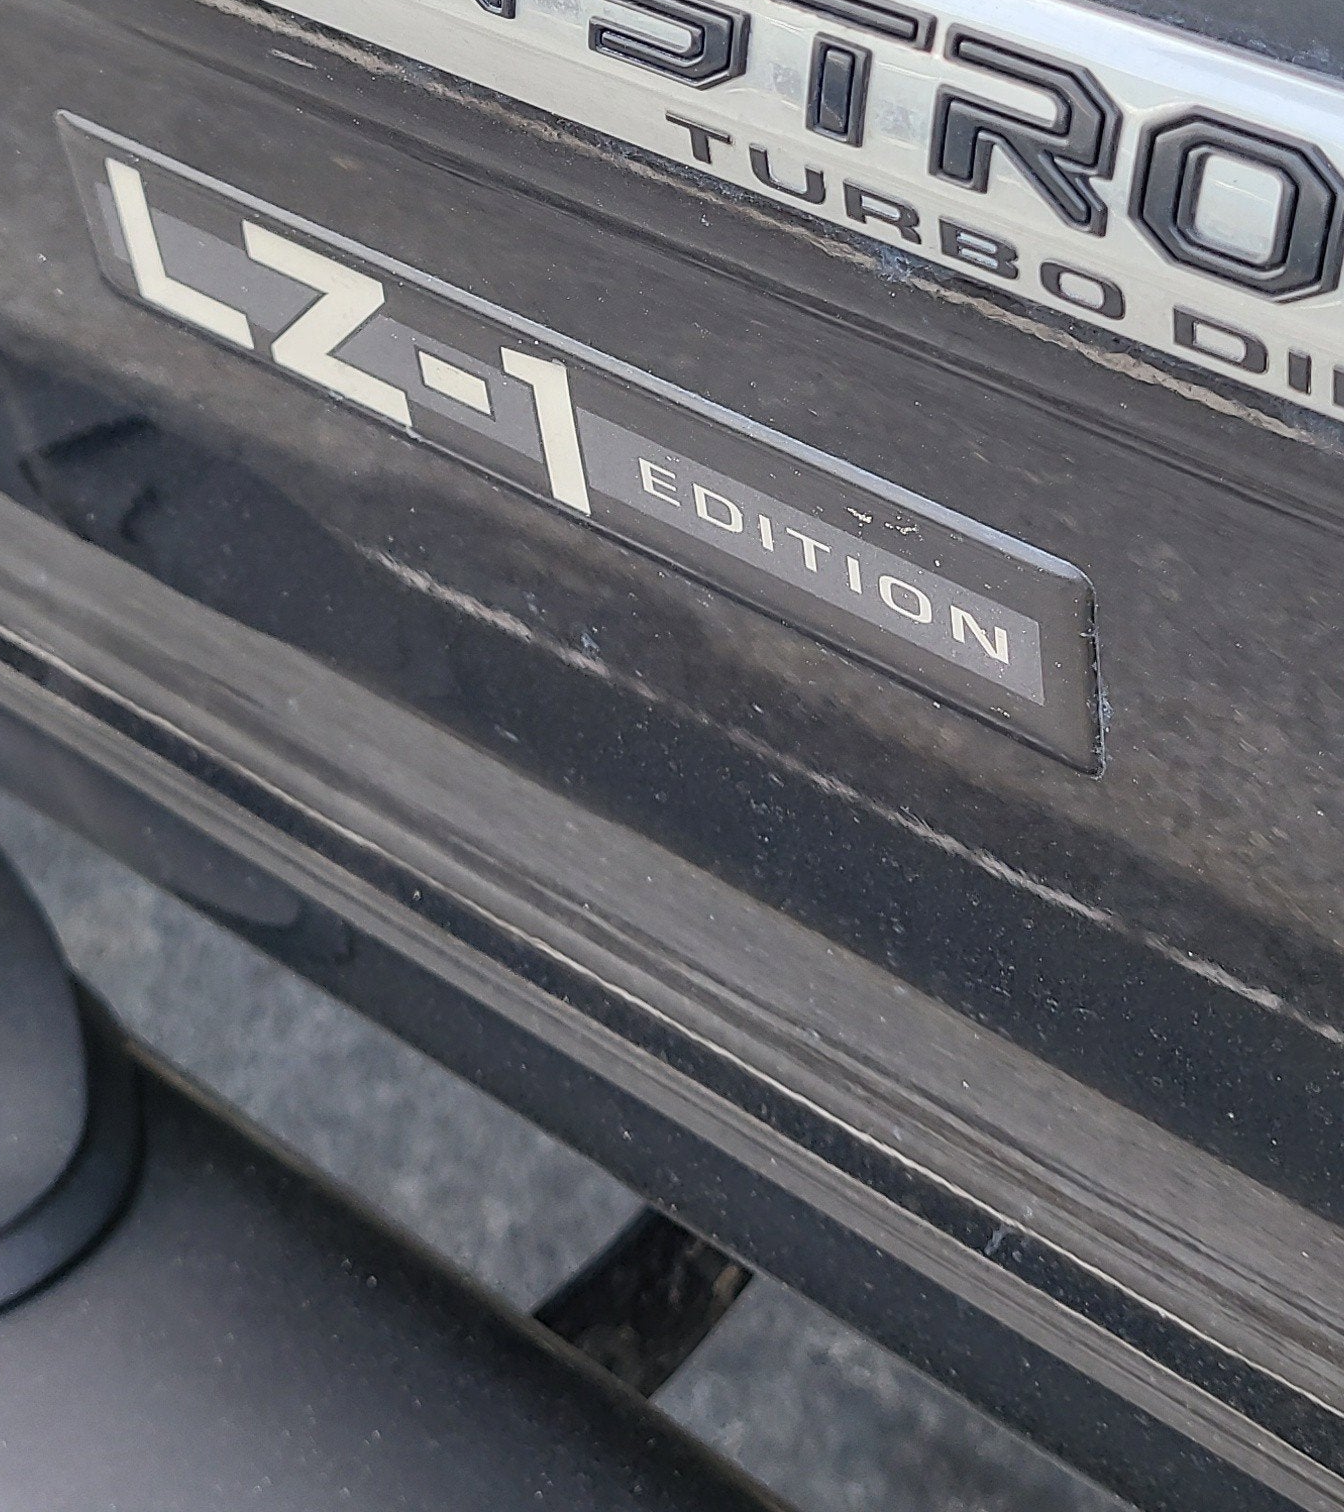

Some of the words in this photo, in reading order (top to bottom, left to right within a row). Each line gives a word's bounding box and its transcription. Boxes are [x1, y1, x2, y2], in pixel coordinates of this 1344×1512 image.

[665, 110, 1126, 320] TURBO
[105, 157, 591, 516] LZ-1
[638, 456, 1010, 665] EDITION
